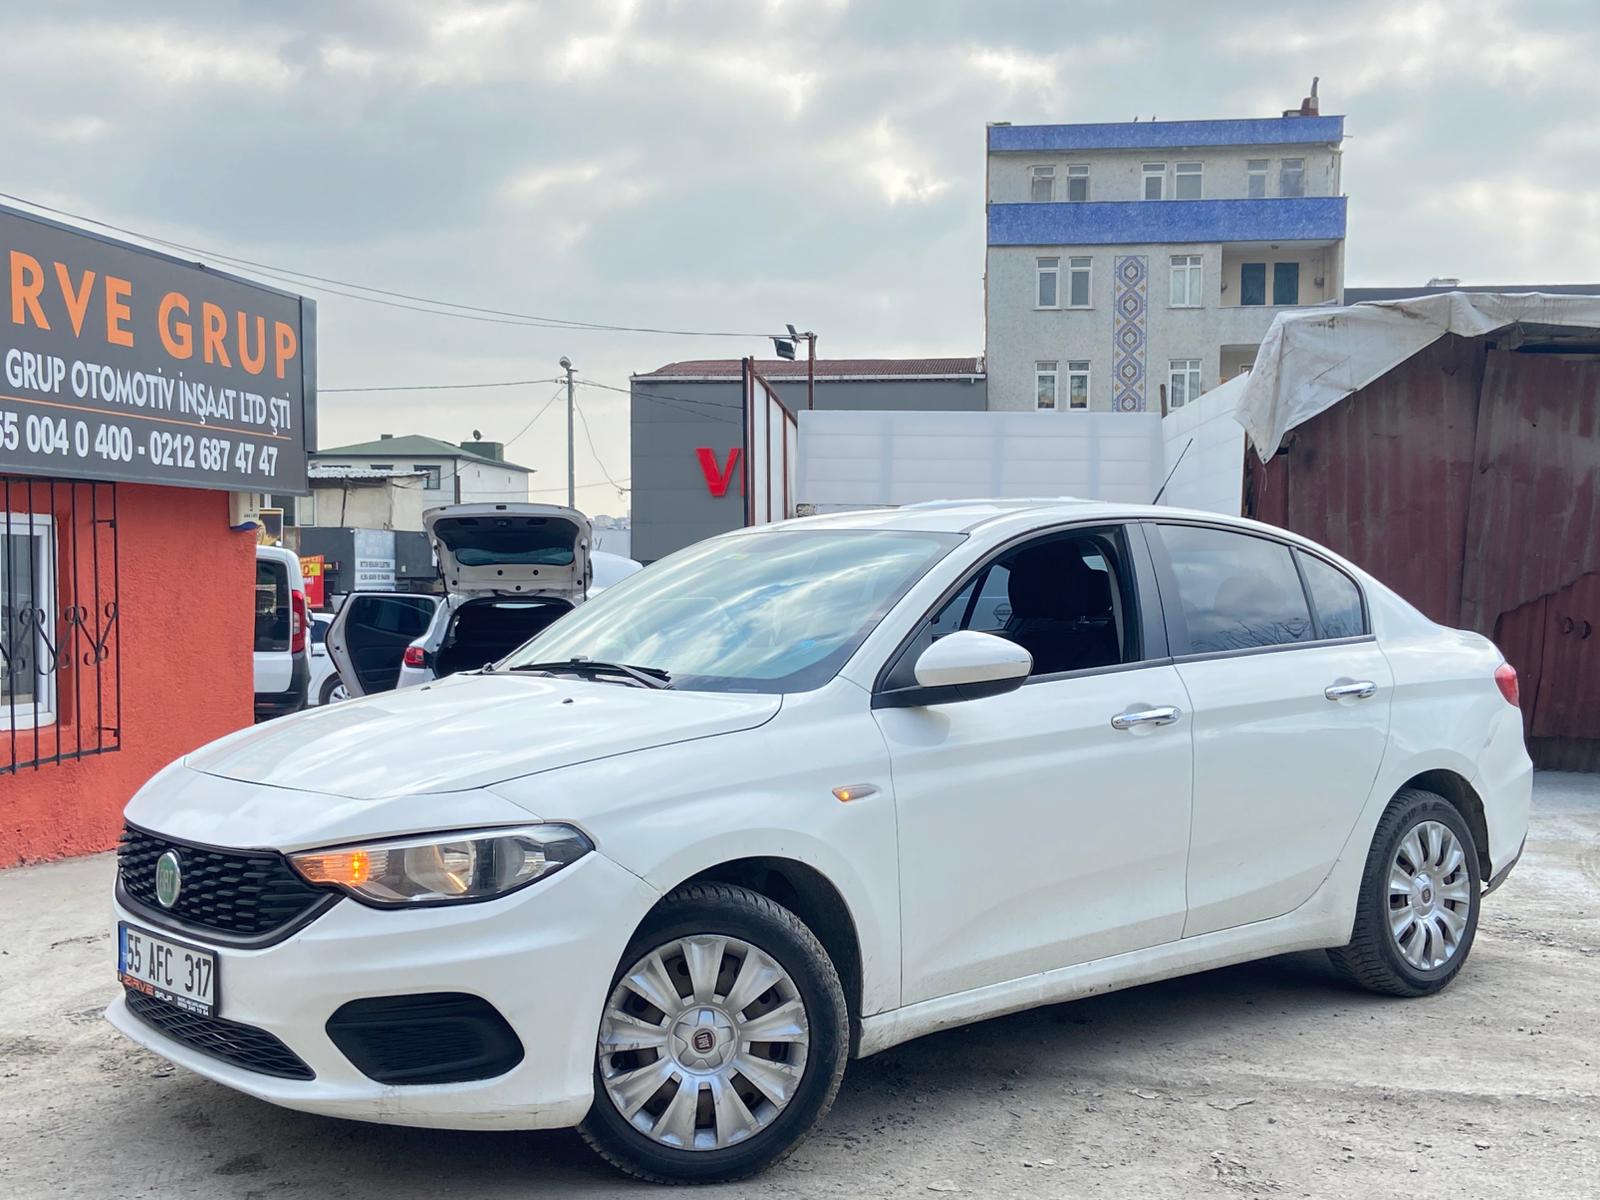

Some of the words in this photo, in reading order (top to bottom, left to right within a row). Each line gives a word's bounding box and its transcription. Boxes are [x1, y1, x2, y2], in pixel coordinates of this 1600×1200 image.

[10, 250, 135, 348] RVE
[158, 291, 297, 379] GRUP
[5, 348, 65, 394] GRUP
[71, 361, 176, 412] OTOMOTİV
[179, 371, 235, 425] İNŞAAT
[239, 391, 267, 426] LTD
[269, 392, 291, 436] ŞTİ
[26, 414, 69, 456] 004
[75, 421, 89, 458] 0
[94, 423, 133, 463] 400
[150, 430, 195, 468] 0212
[200, 436, 230, 472] 687
[235, 443, 255, 475] 47
[258, 446, 278, 477] 47
[695, 447, 745, 497] V
[127, 933, 141, 974] 55
[149, 942, 173, 987] AFC
[184, 953, 212, 998] 317
